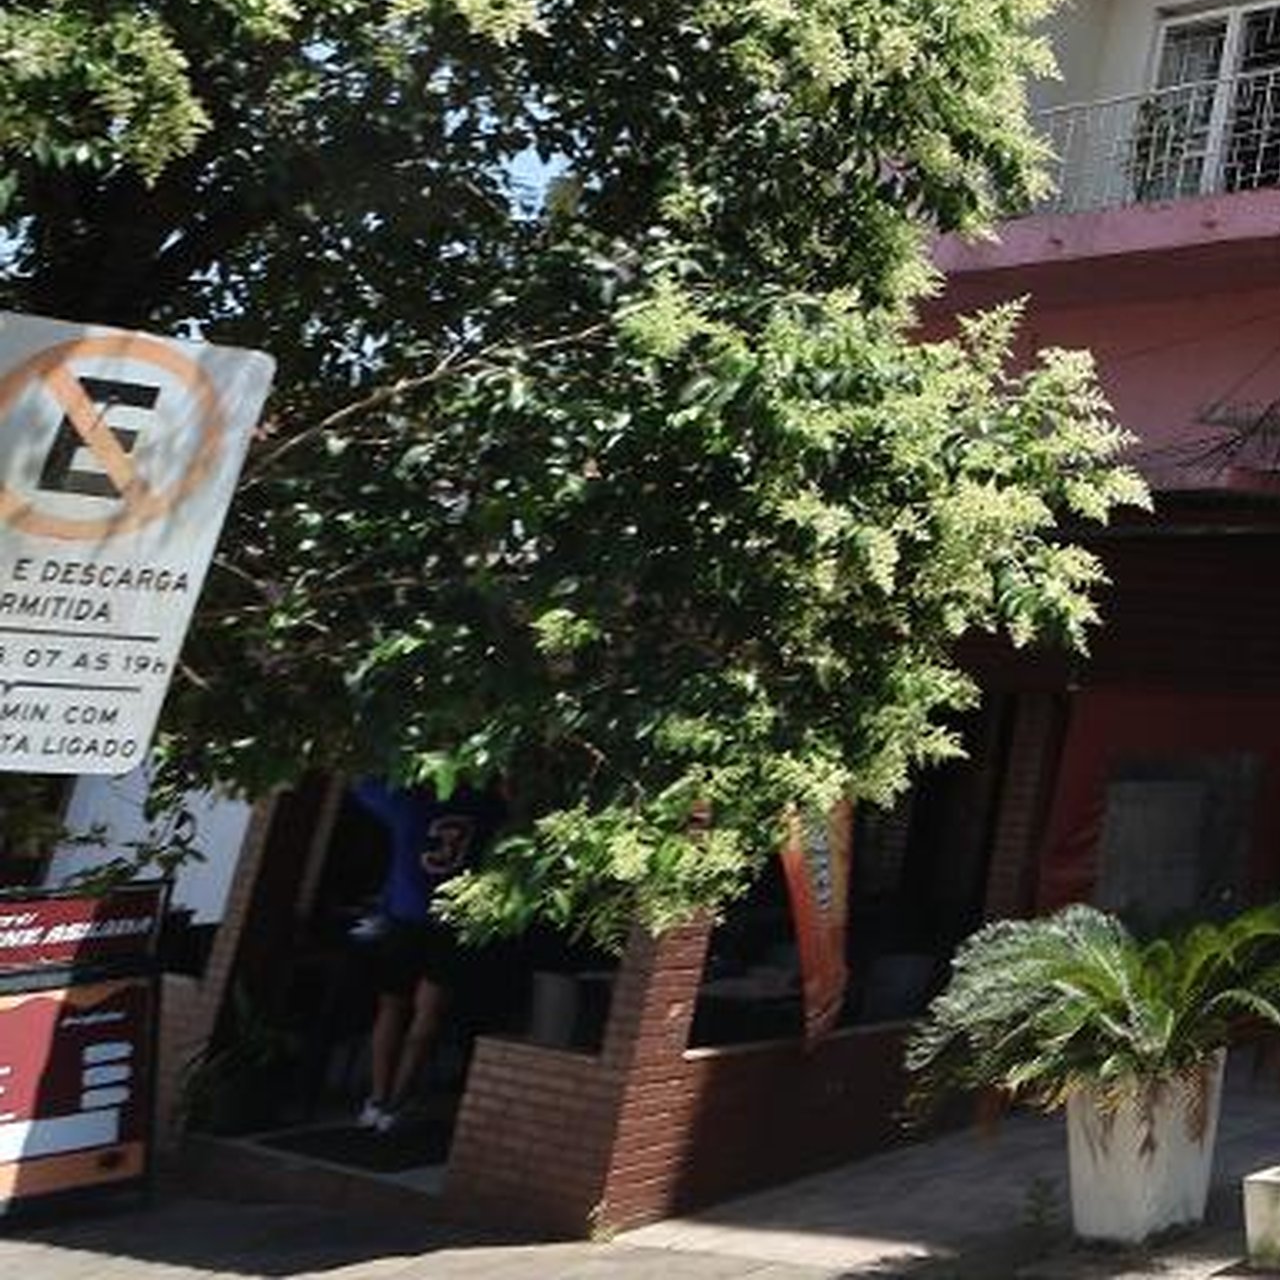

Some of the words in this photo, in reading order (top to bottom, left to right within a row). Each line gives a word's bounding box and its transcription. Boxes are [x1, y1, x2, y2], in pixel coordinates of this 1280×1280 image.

[13, 558, 32, 581] E
[41, 559, 189, 593] DESCARGA
[23, 648, 61, 668] 07
[62, 705, 119, 725] COM
[41, 736, 138, 758] LIGADO
